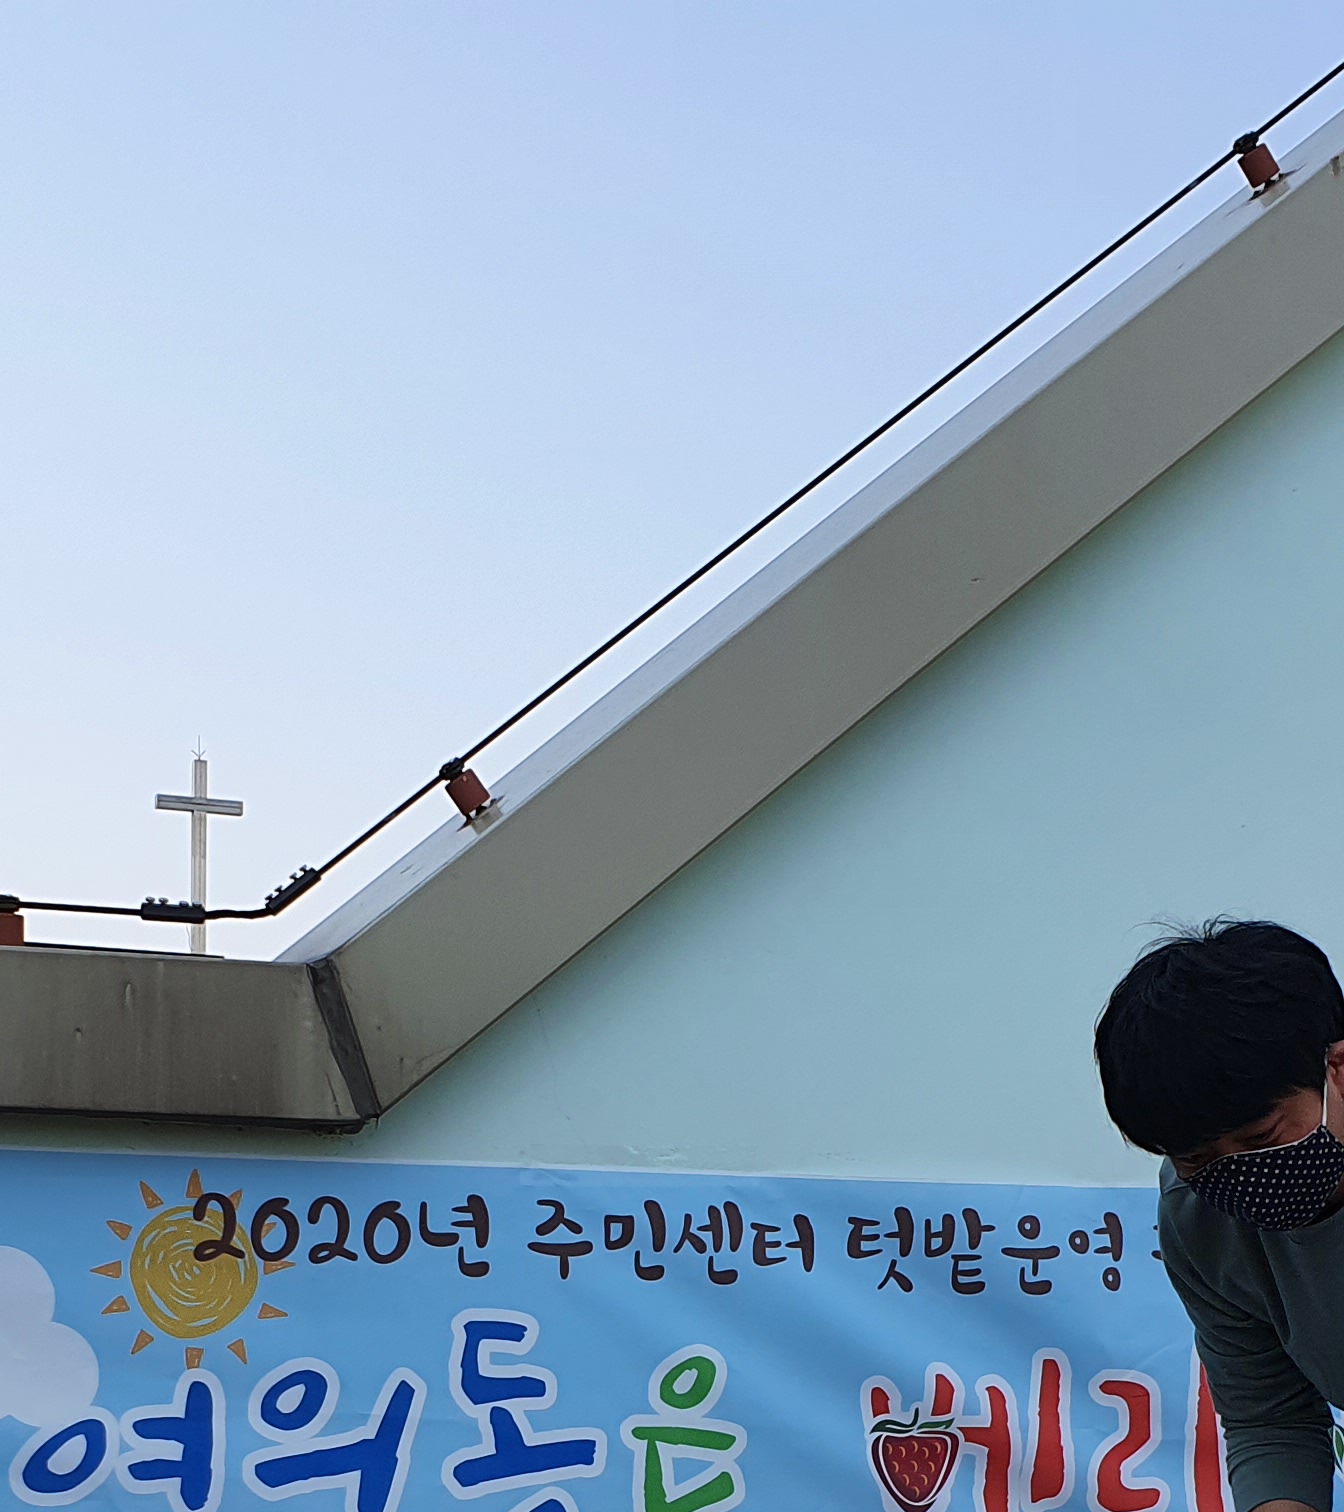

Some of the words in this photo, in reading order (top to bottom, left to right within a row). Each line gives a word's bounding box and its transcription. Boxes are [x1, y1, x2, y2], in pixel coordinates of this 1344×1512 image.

[193, 1192, 491, 1278] 2020년
[527, 1199, 816, 1285] 주민센터
[847, 1207, 1124, 1296] 텃밭운영
